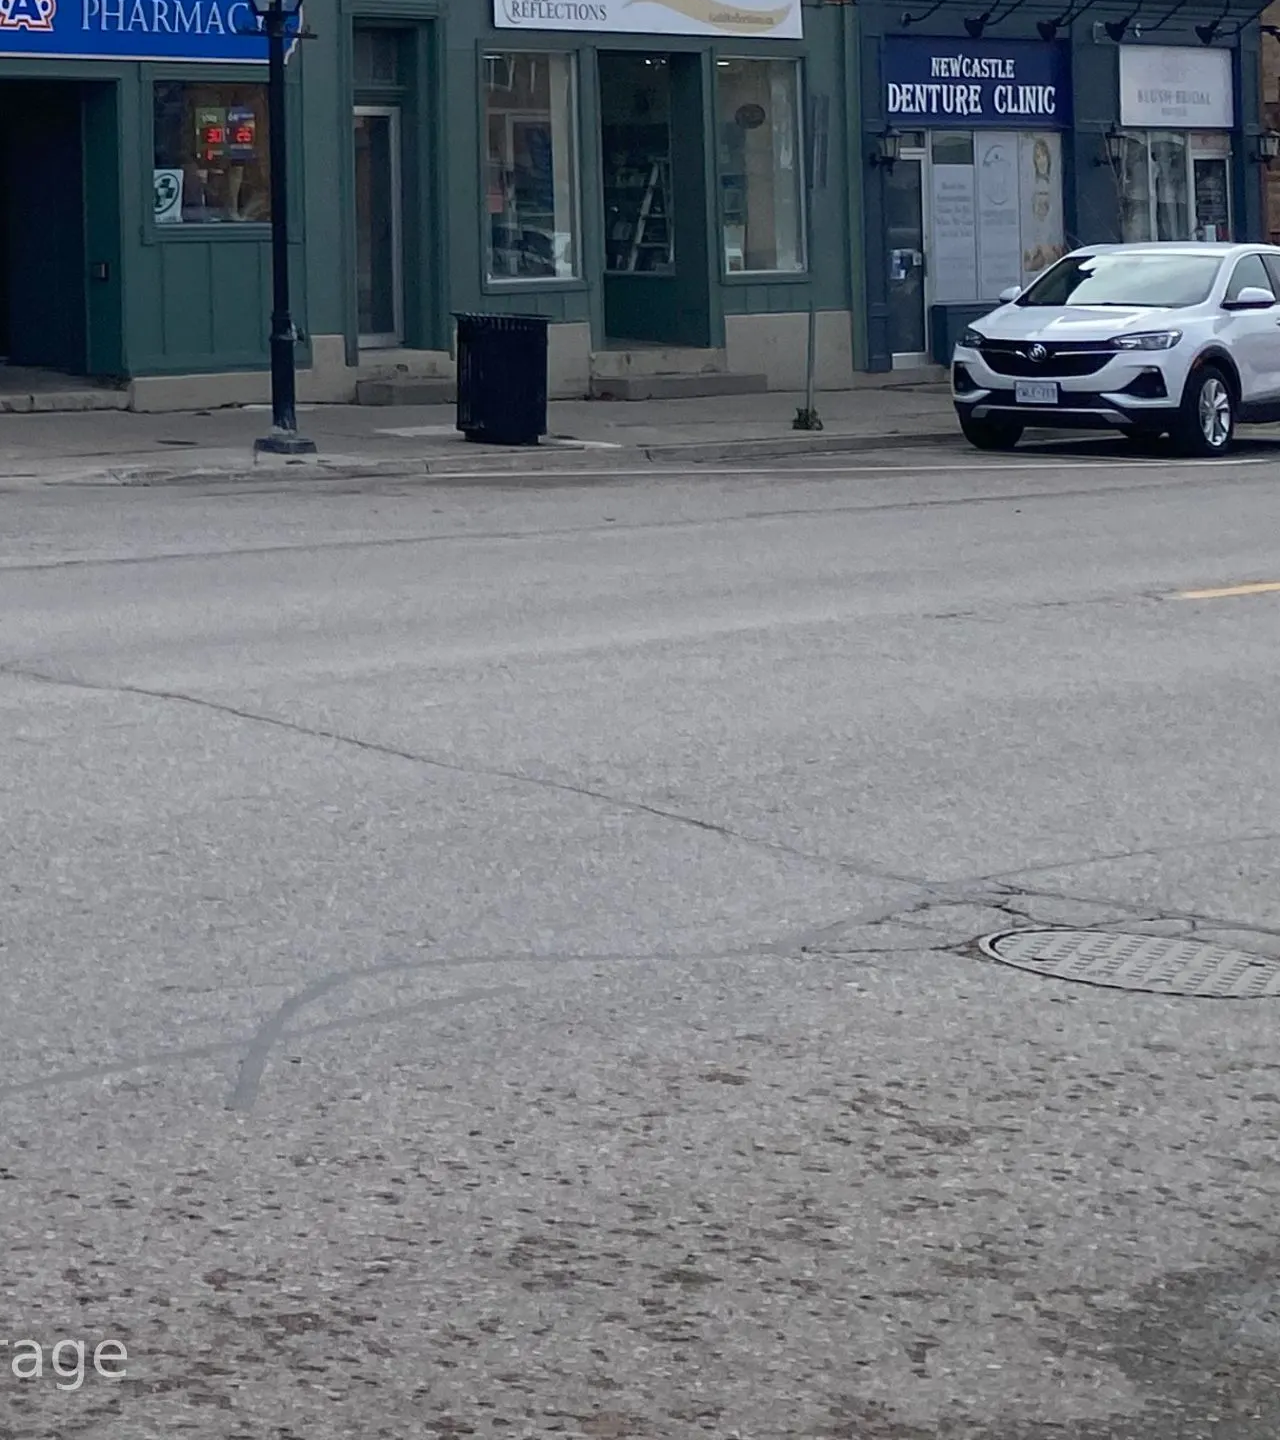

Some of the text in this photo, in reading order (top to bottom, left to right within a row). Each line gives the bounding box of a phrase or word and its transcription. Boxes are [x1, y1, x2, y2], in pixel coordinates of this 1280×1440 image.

[511, 0, 608, 22] REFLECTIONS
[931, 54, 1015, 78] NEWCASTLE
[887, 83, 1056, 116] DENTURE CLINIC
